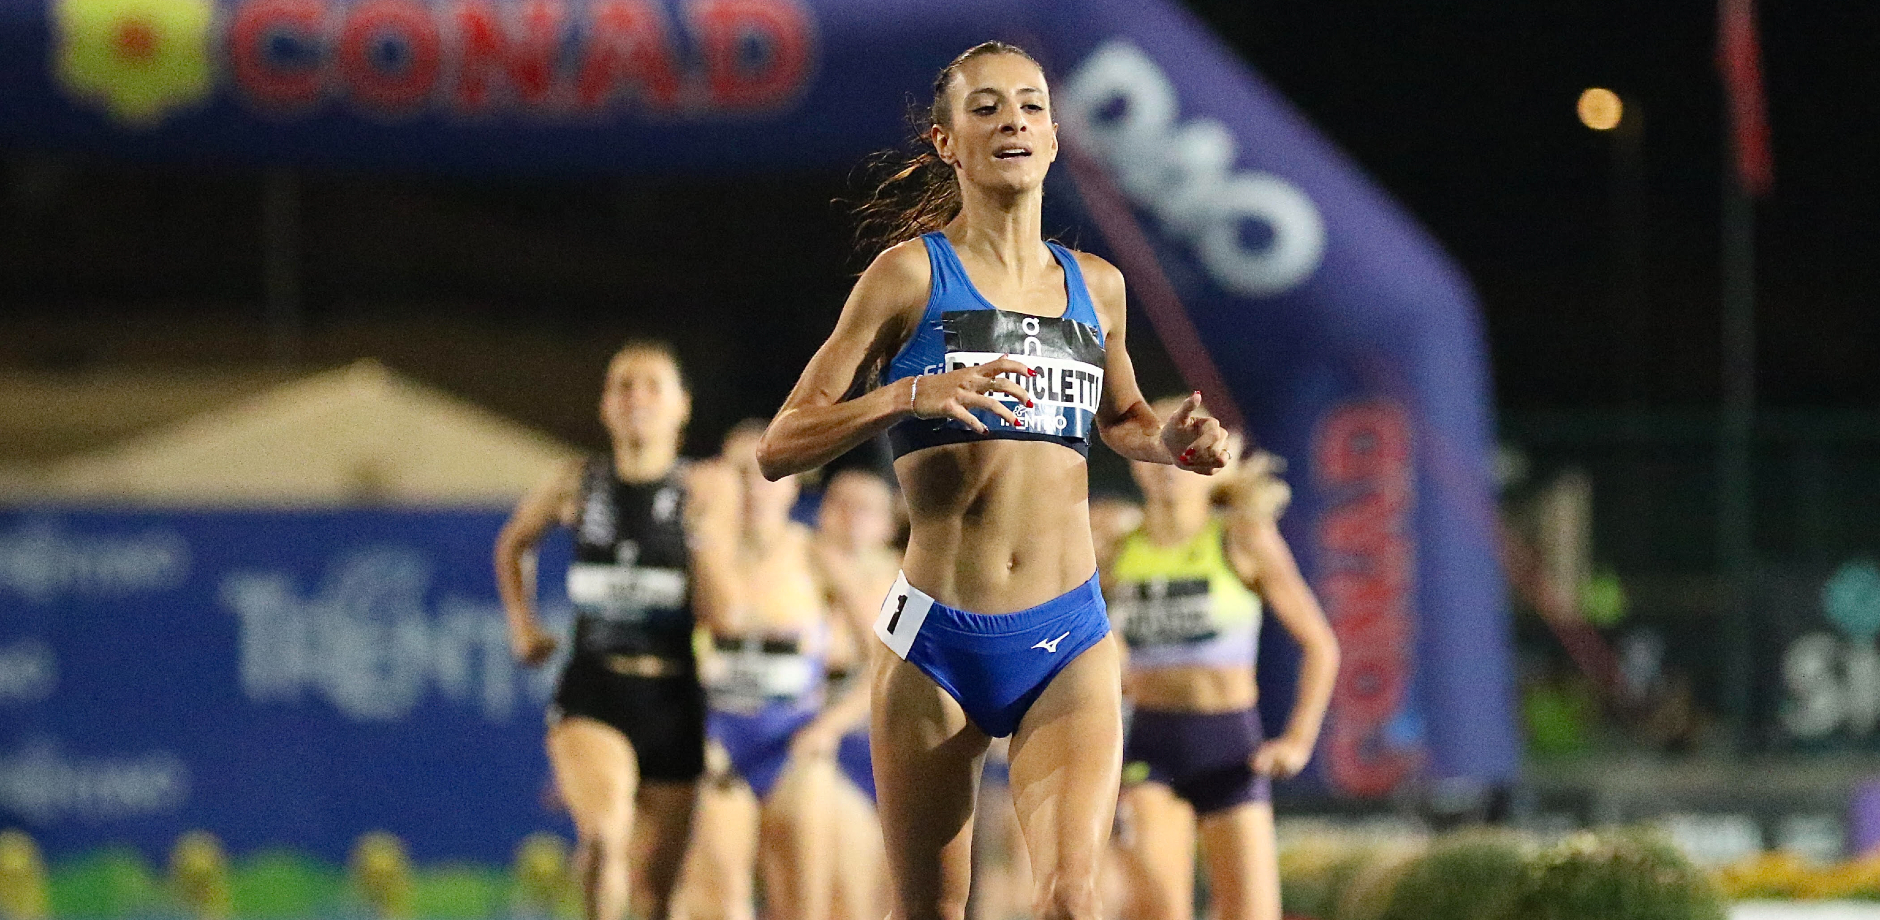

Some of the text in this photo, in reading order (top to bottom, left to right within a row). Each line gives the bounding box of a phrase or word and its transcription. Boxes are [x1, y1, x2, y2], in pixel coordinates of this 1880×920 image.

[226, 0, 812, 112] CONAD
[952, 362, 1099, 410] OCLETTI
[887, 594, 908, 635] 1
